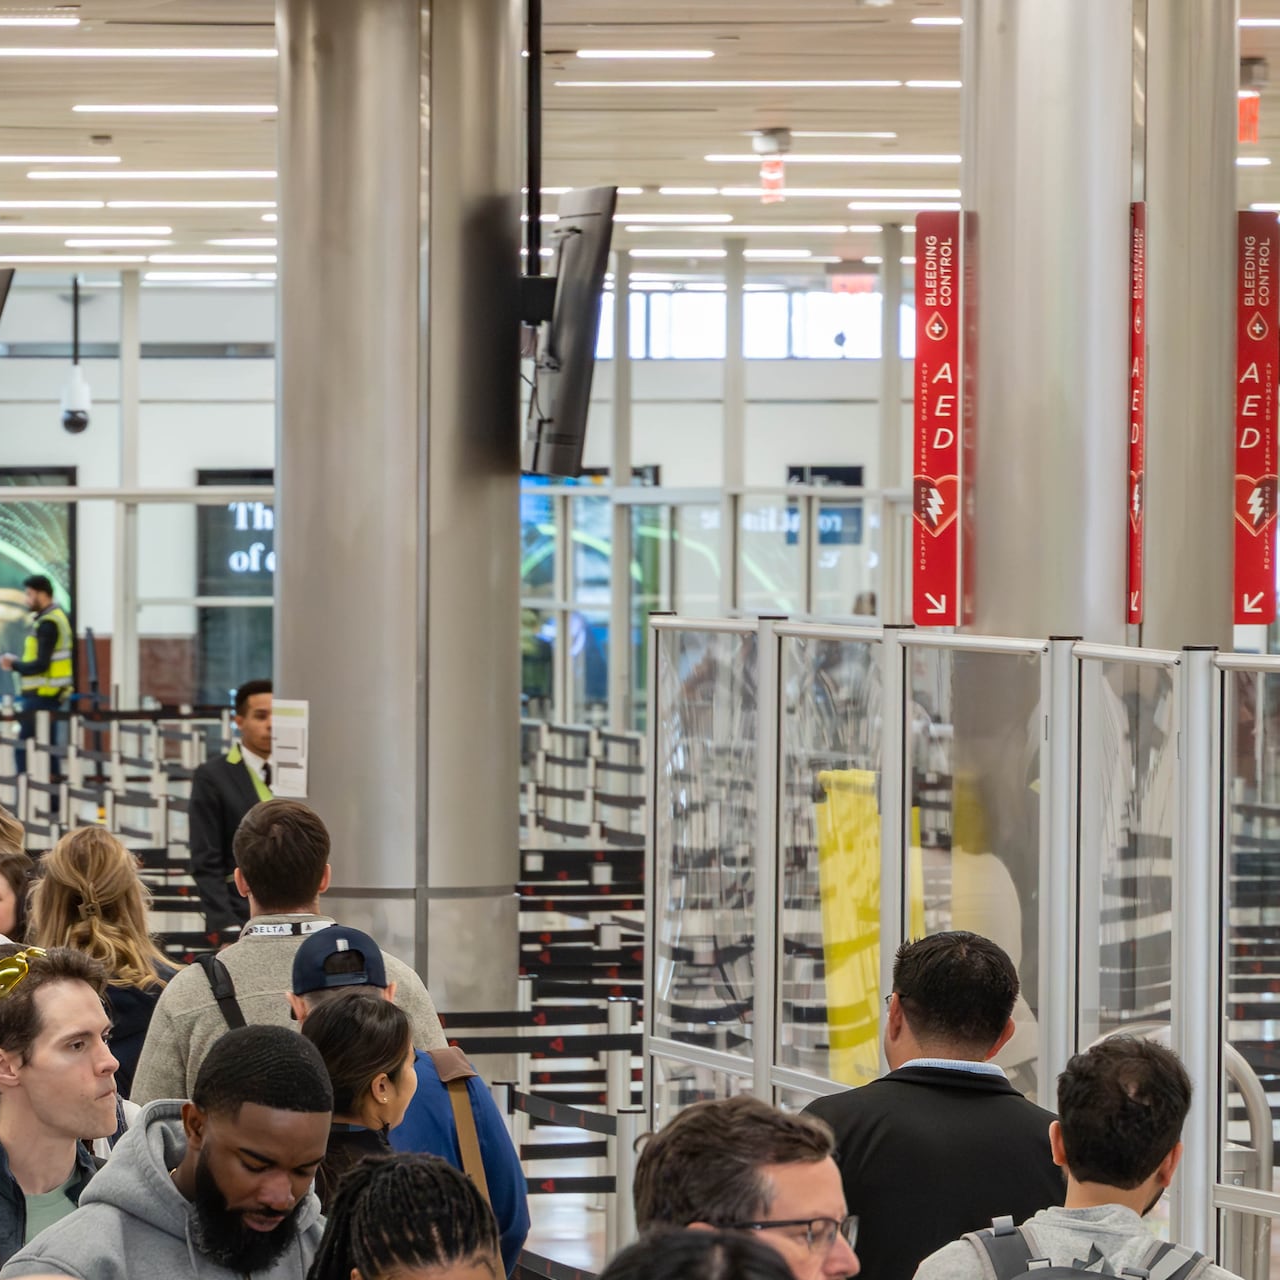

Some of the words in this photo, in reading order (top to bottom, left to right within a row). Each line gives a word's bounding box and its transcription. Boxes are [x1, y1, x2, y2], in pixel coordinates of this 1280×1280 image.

[925, 235, 938, 307] BLEEDING
[940, 237, 952, 307] CONTROL
[1244, 235, 1256, 306] BLEEDING
[1258, 237, 1270, 307] CONTROL
[932, 362, 955, 449] AED
[1239, 362, 1262, 449] AED
[229, 542, 265, 573] of
